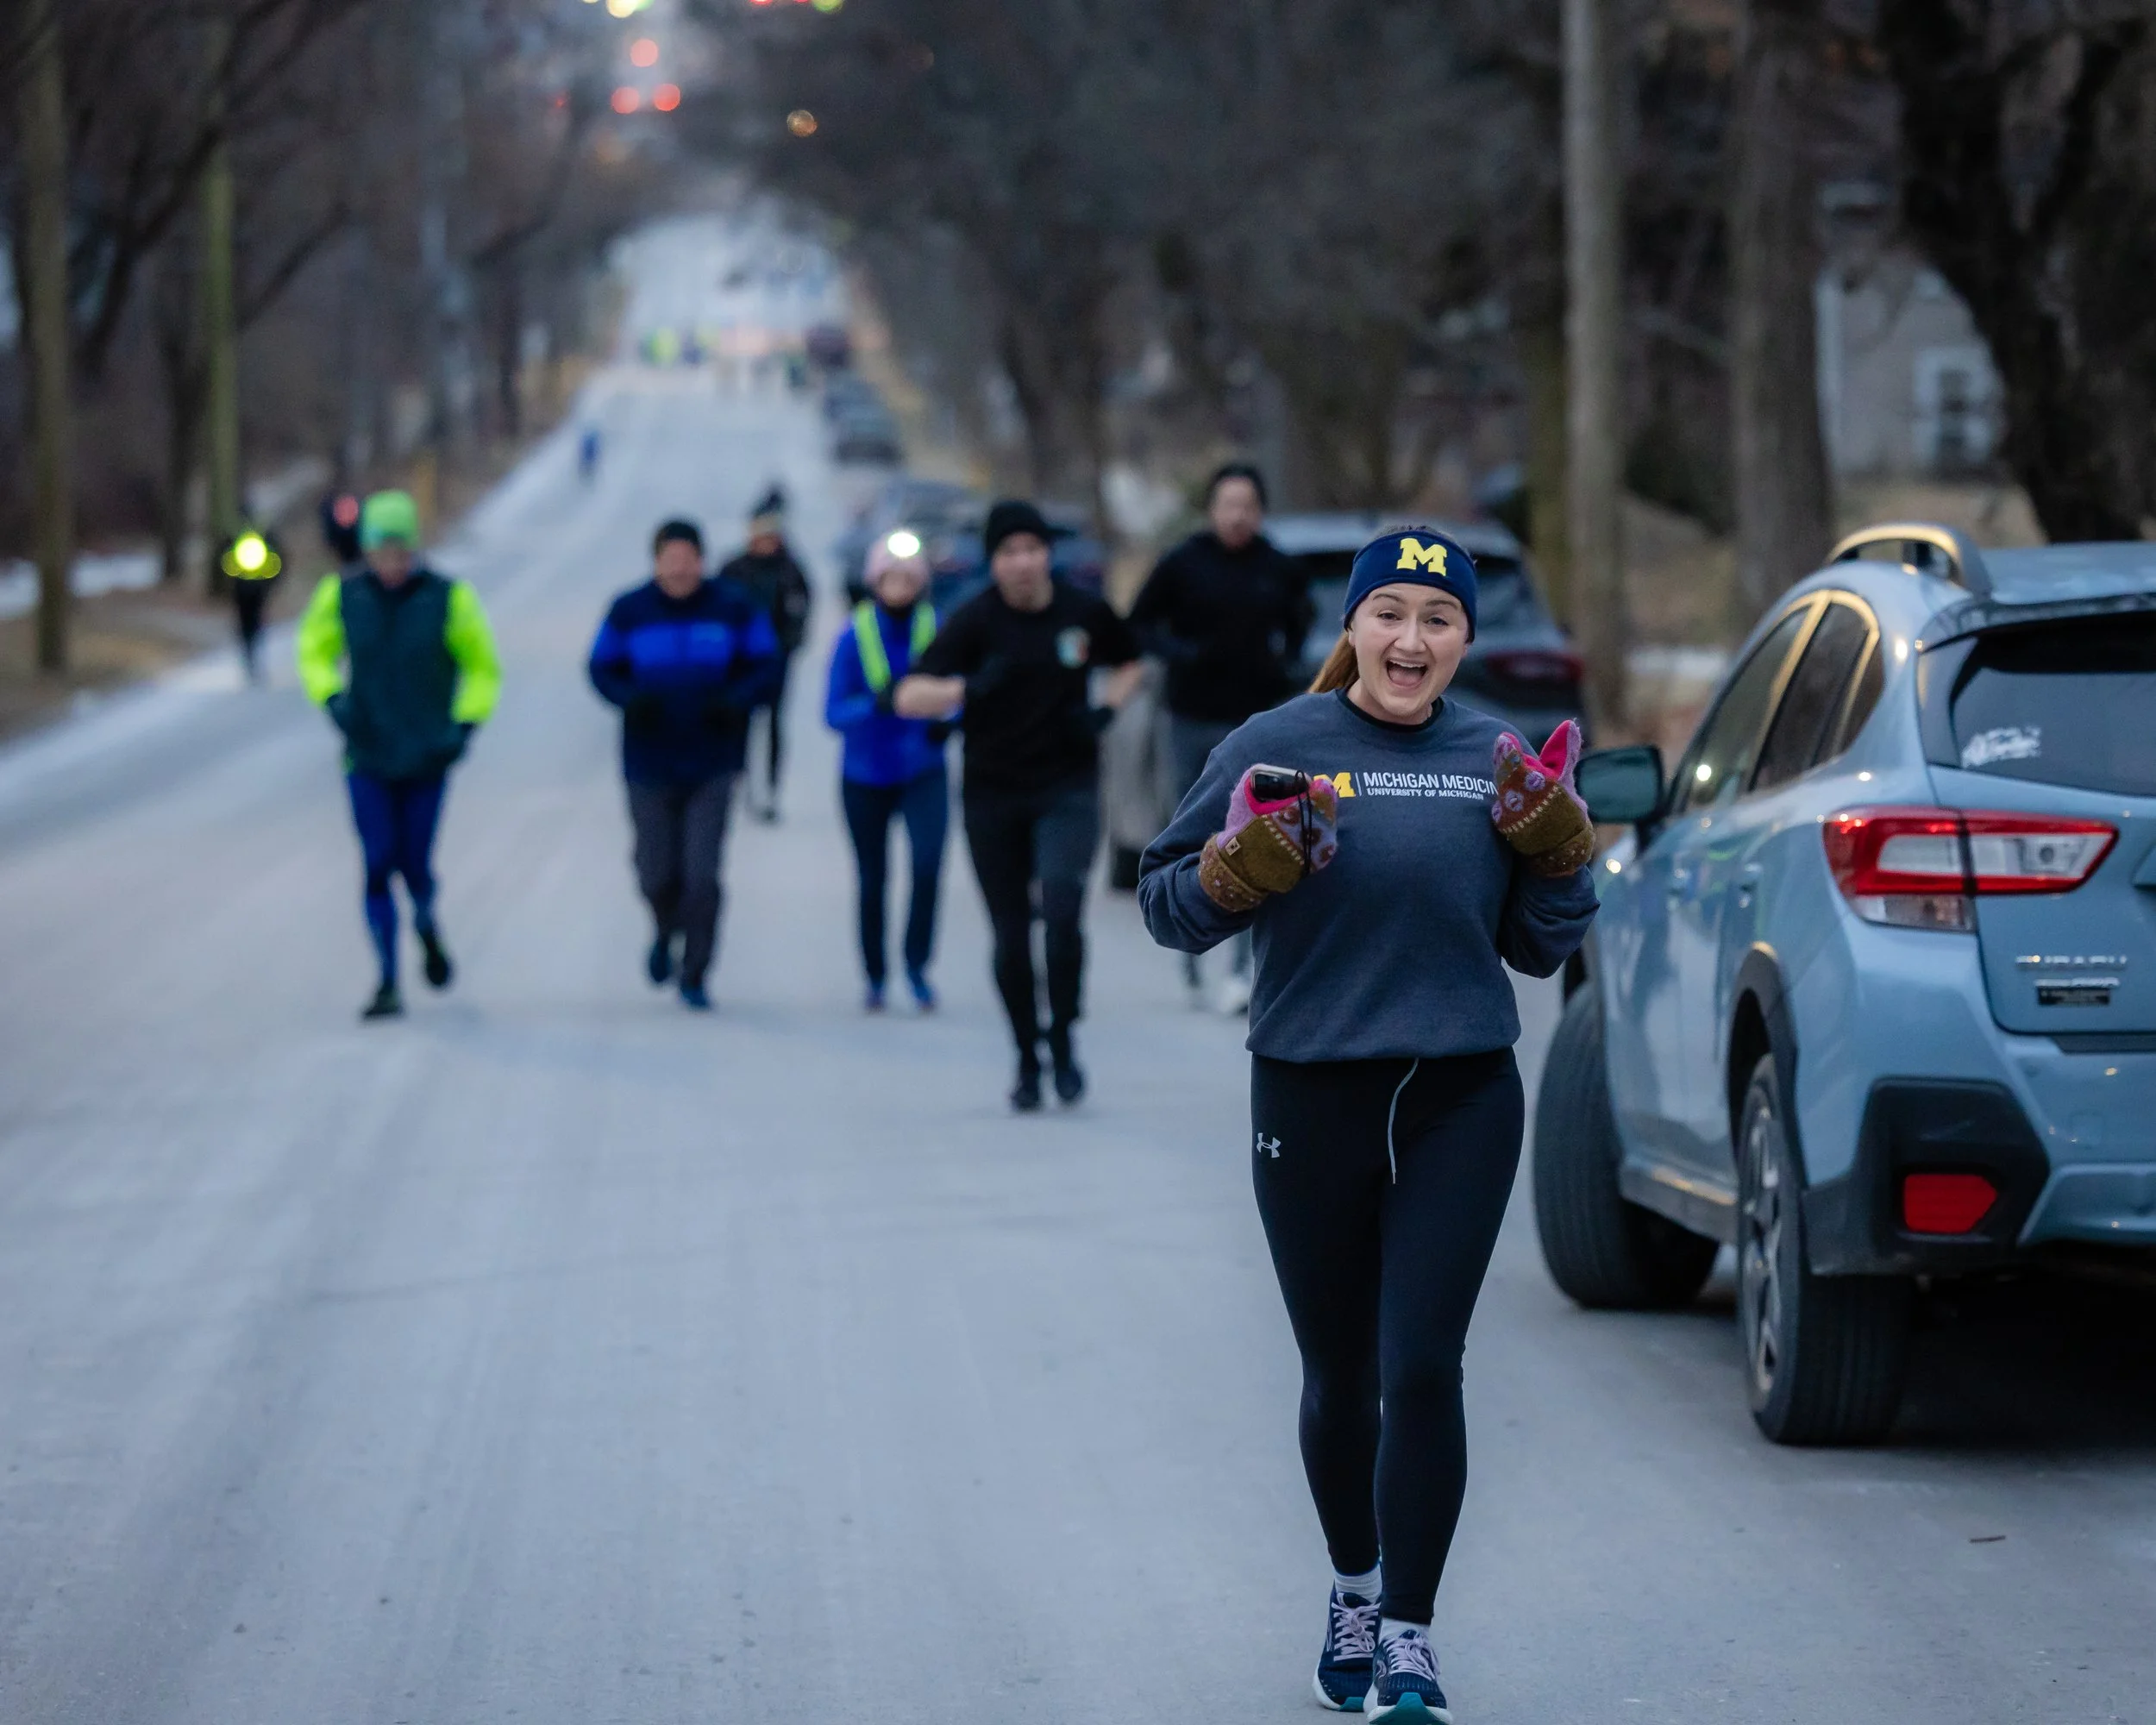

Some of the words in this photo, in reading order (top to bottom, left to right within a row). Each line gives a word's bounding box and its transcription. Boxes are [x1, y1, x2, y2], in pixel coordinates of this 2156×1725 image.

[1396, 537, 1448, 577] M
[1363, 771, 1439, 789] MICHIGAN
[1442, 774, 1499, 796] MEDICIN
[1366, 787, 1423, 797] UNIVERSITY
[1438, 789, 1484, 800] MICHIGAN
